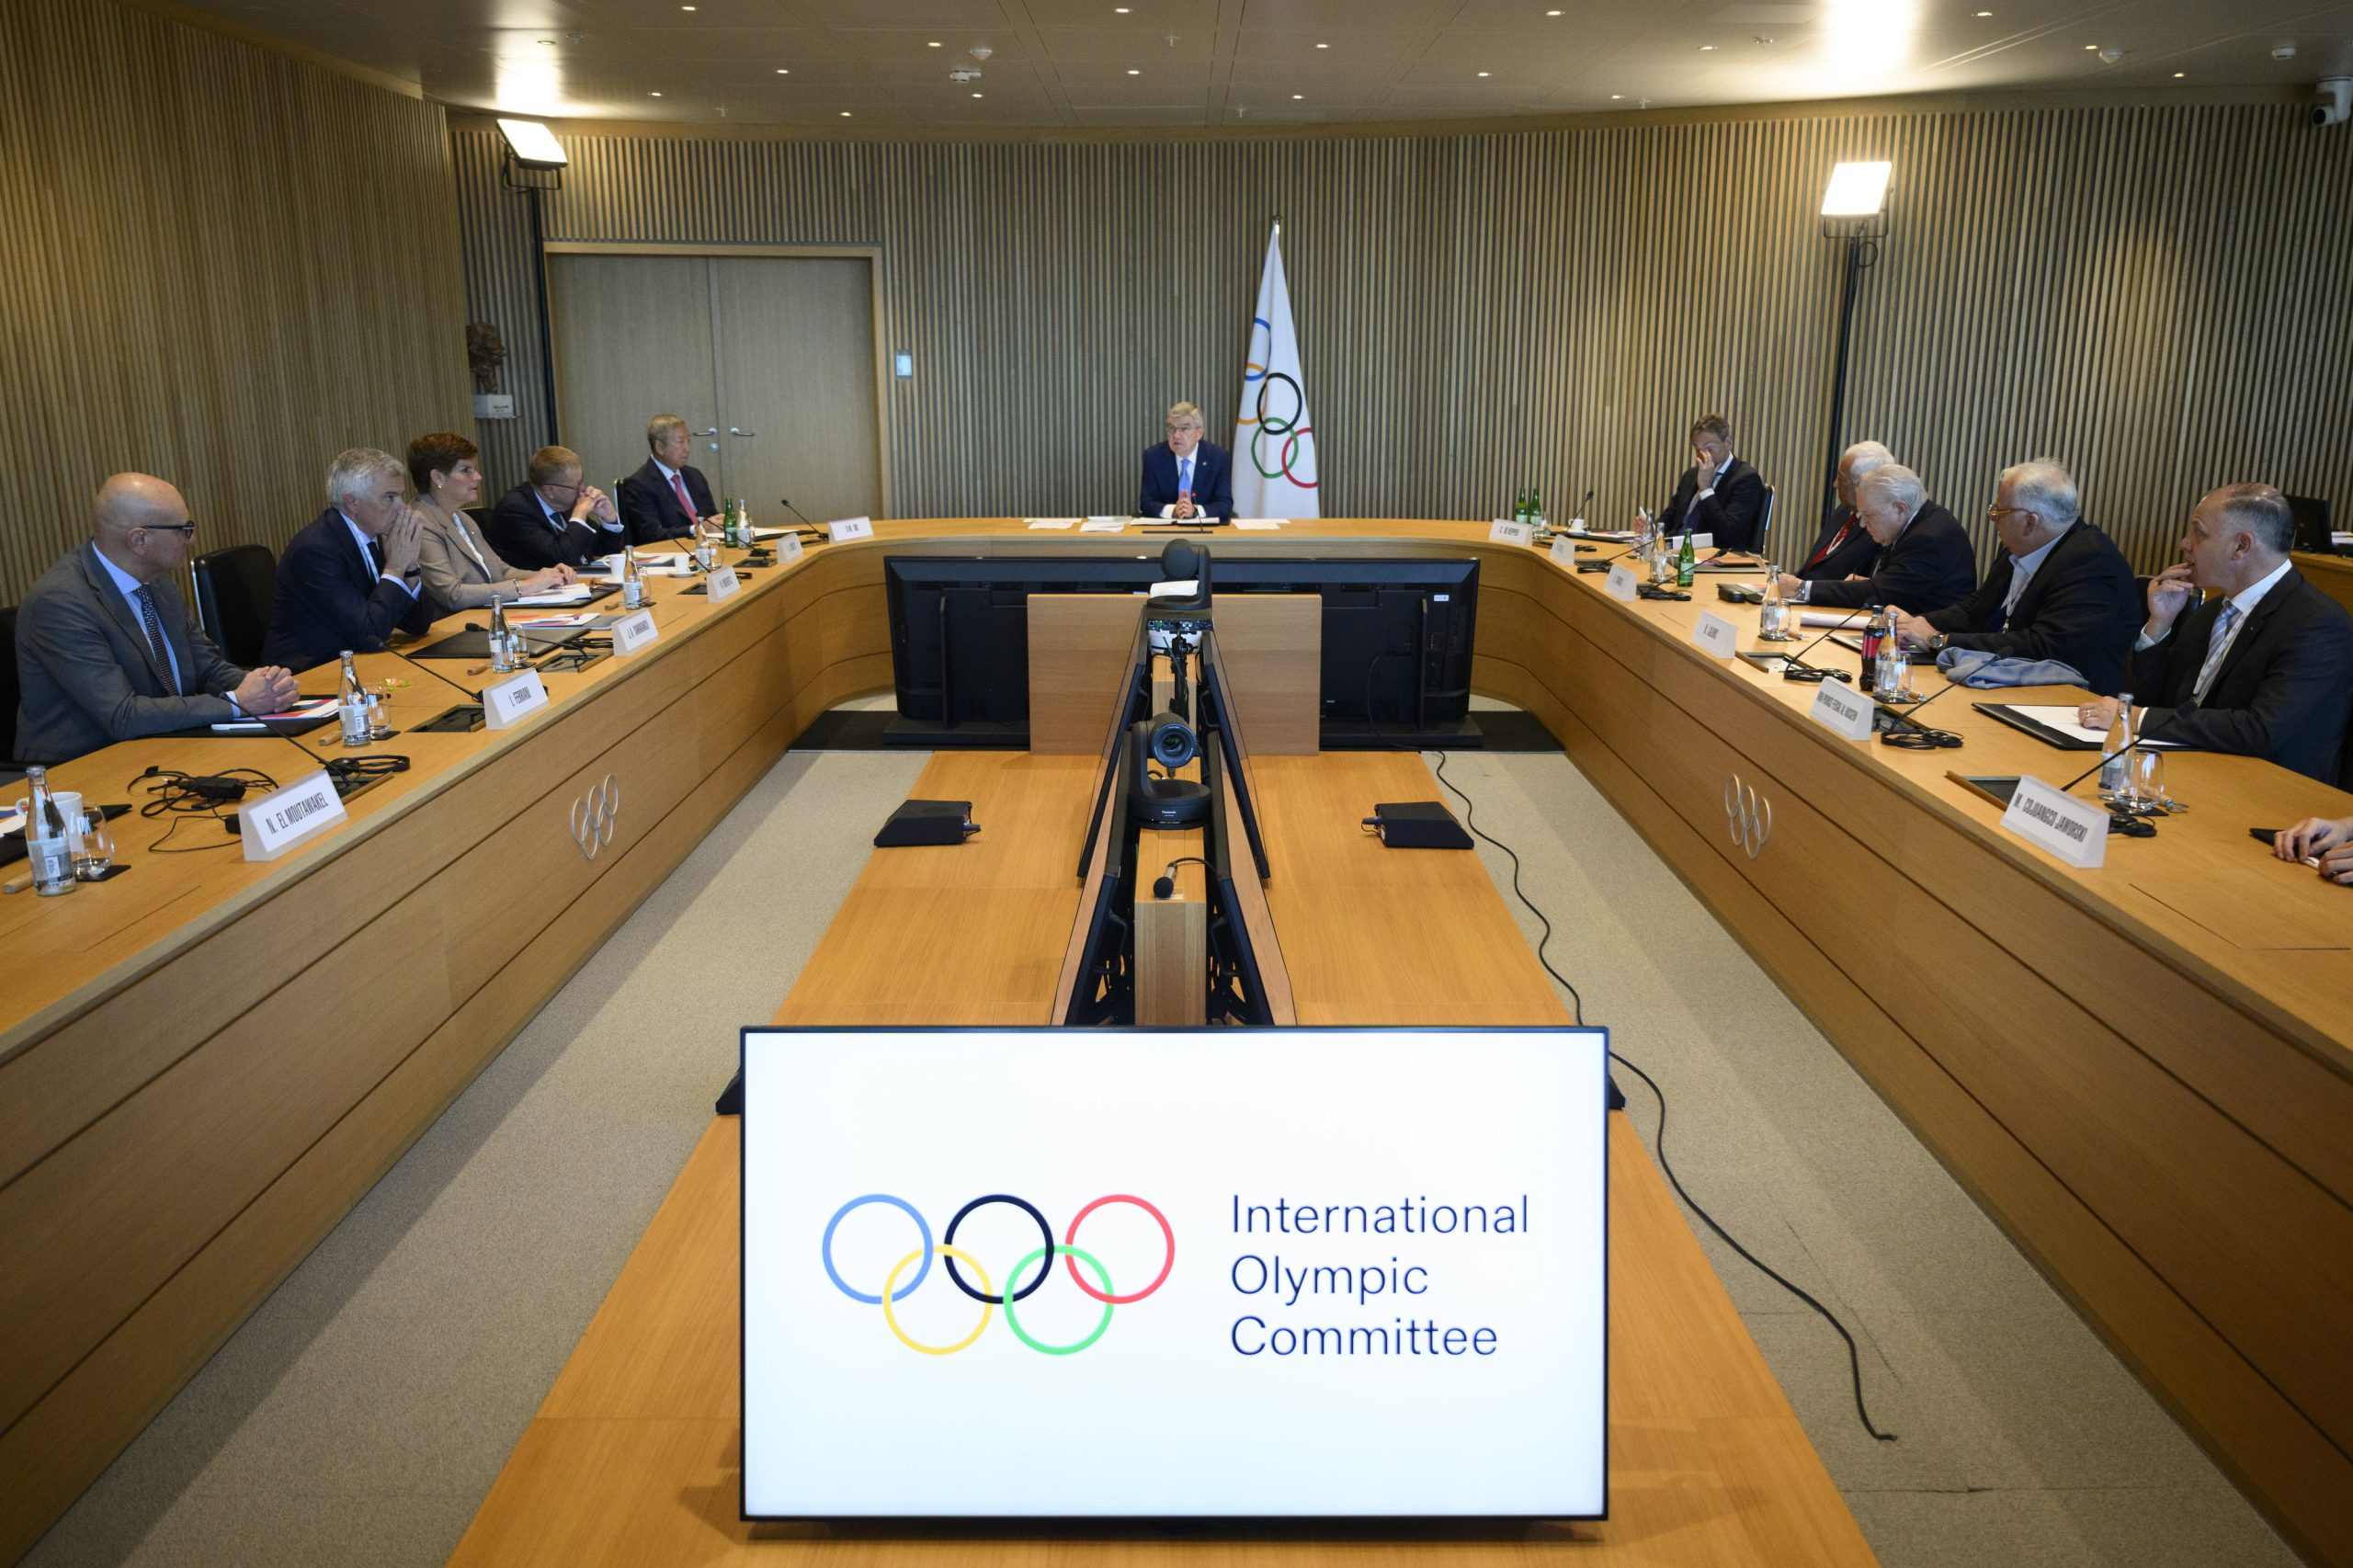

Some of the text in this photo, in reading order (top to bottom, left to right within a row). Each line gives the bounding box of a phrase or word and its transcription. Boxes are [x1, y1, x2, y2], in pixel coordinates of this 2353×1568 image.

[266, 792, 328, 835] N. EL MOUTAWAKEL
[2022, 798, 2058, 827] COJUANGCO
[2054, 815, 2088, 843] JAWORSKI
[1234, 1195, 1527, 1233] International
[1232, 1256, 1427, 1306] Olympic
[1232, 1316, 1496, 1355] Committee
